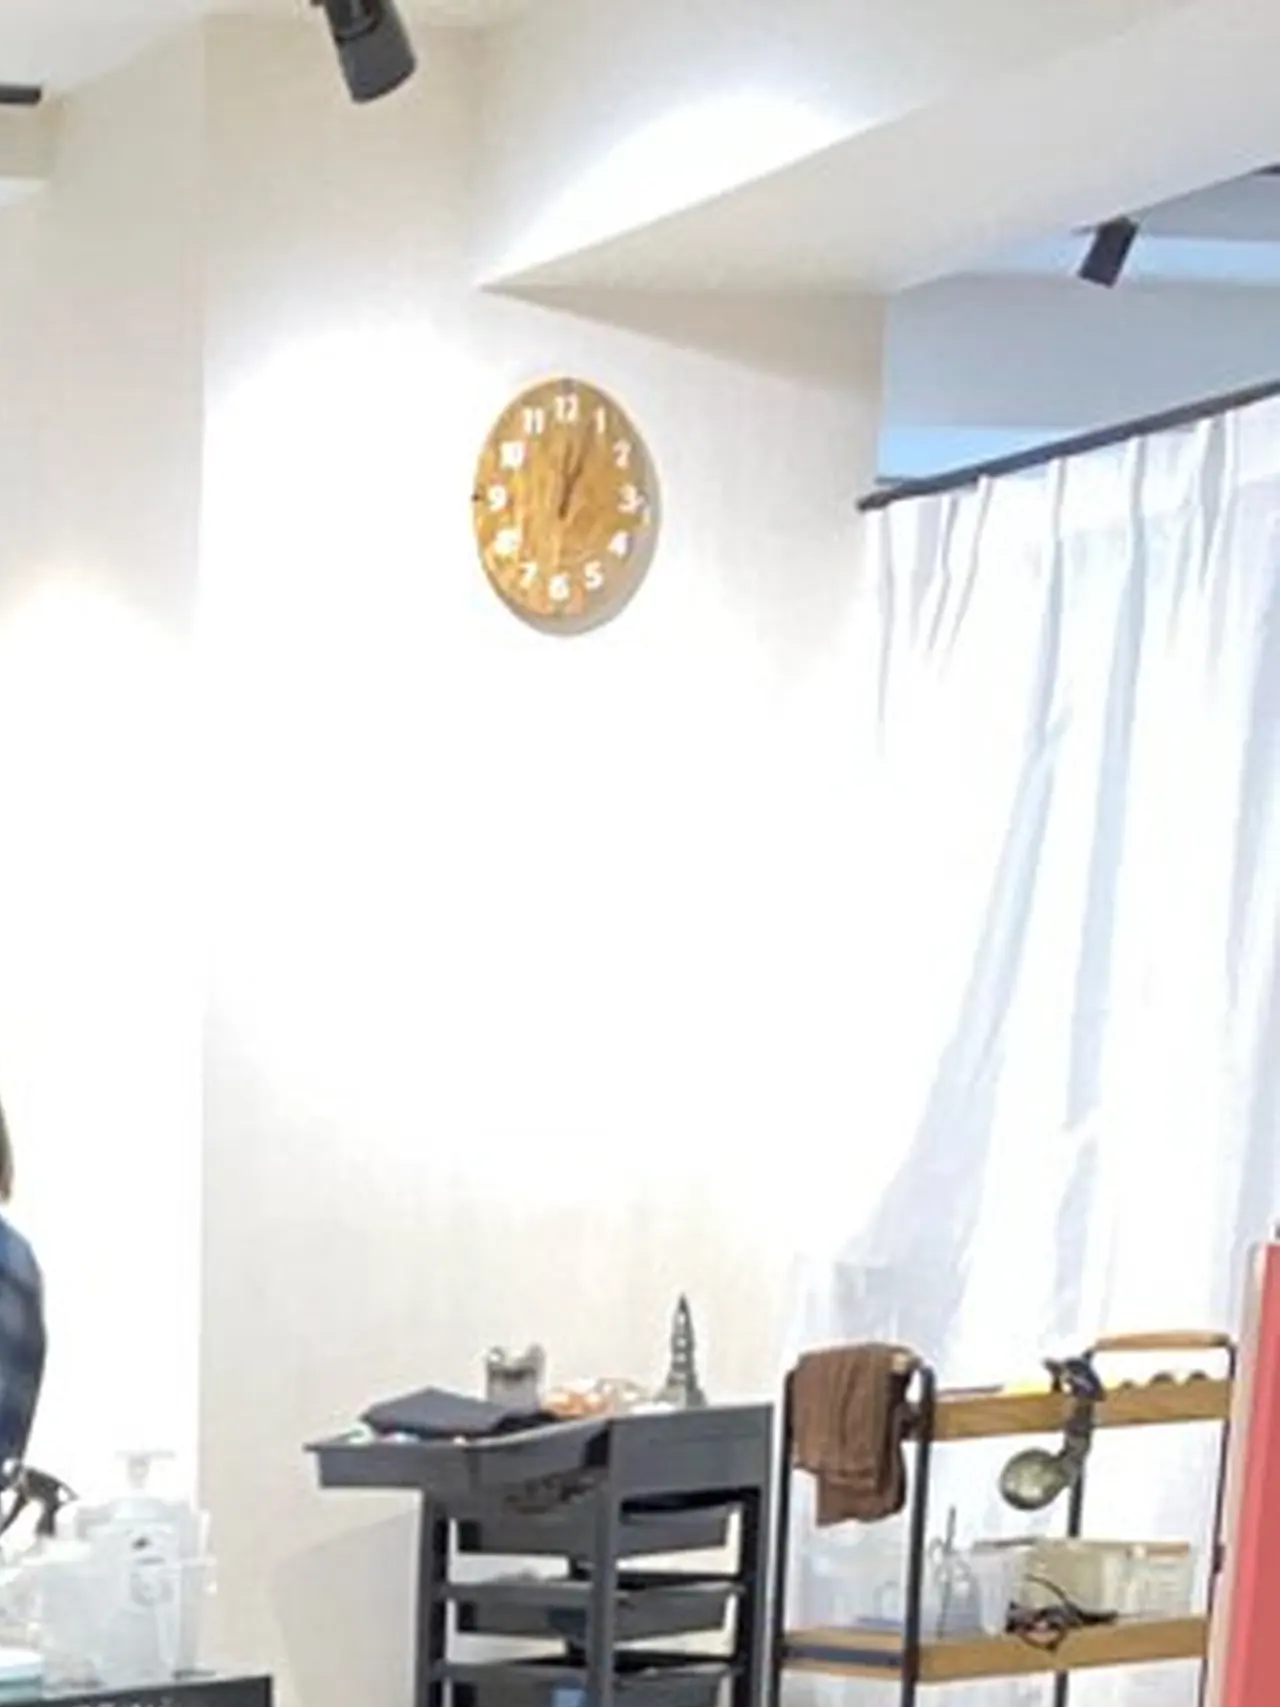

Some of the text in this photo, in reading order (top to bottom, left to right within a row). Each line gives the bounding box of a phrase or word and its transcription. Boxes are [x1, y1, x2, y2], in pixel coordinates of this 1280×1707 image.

[523, 407, 545, 434] 11
[555, 394, 579, 422] 12
[613, 439, 632, 469] 2
[487, 484, 507, 511] 9
[618, 485, 640, 513] 3
[520, 562, 538, 588] 7
[548, 574, 569, 600] 6
[584, 562, 603, 589] 5
